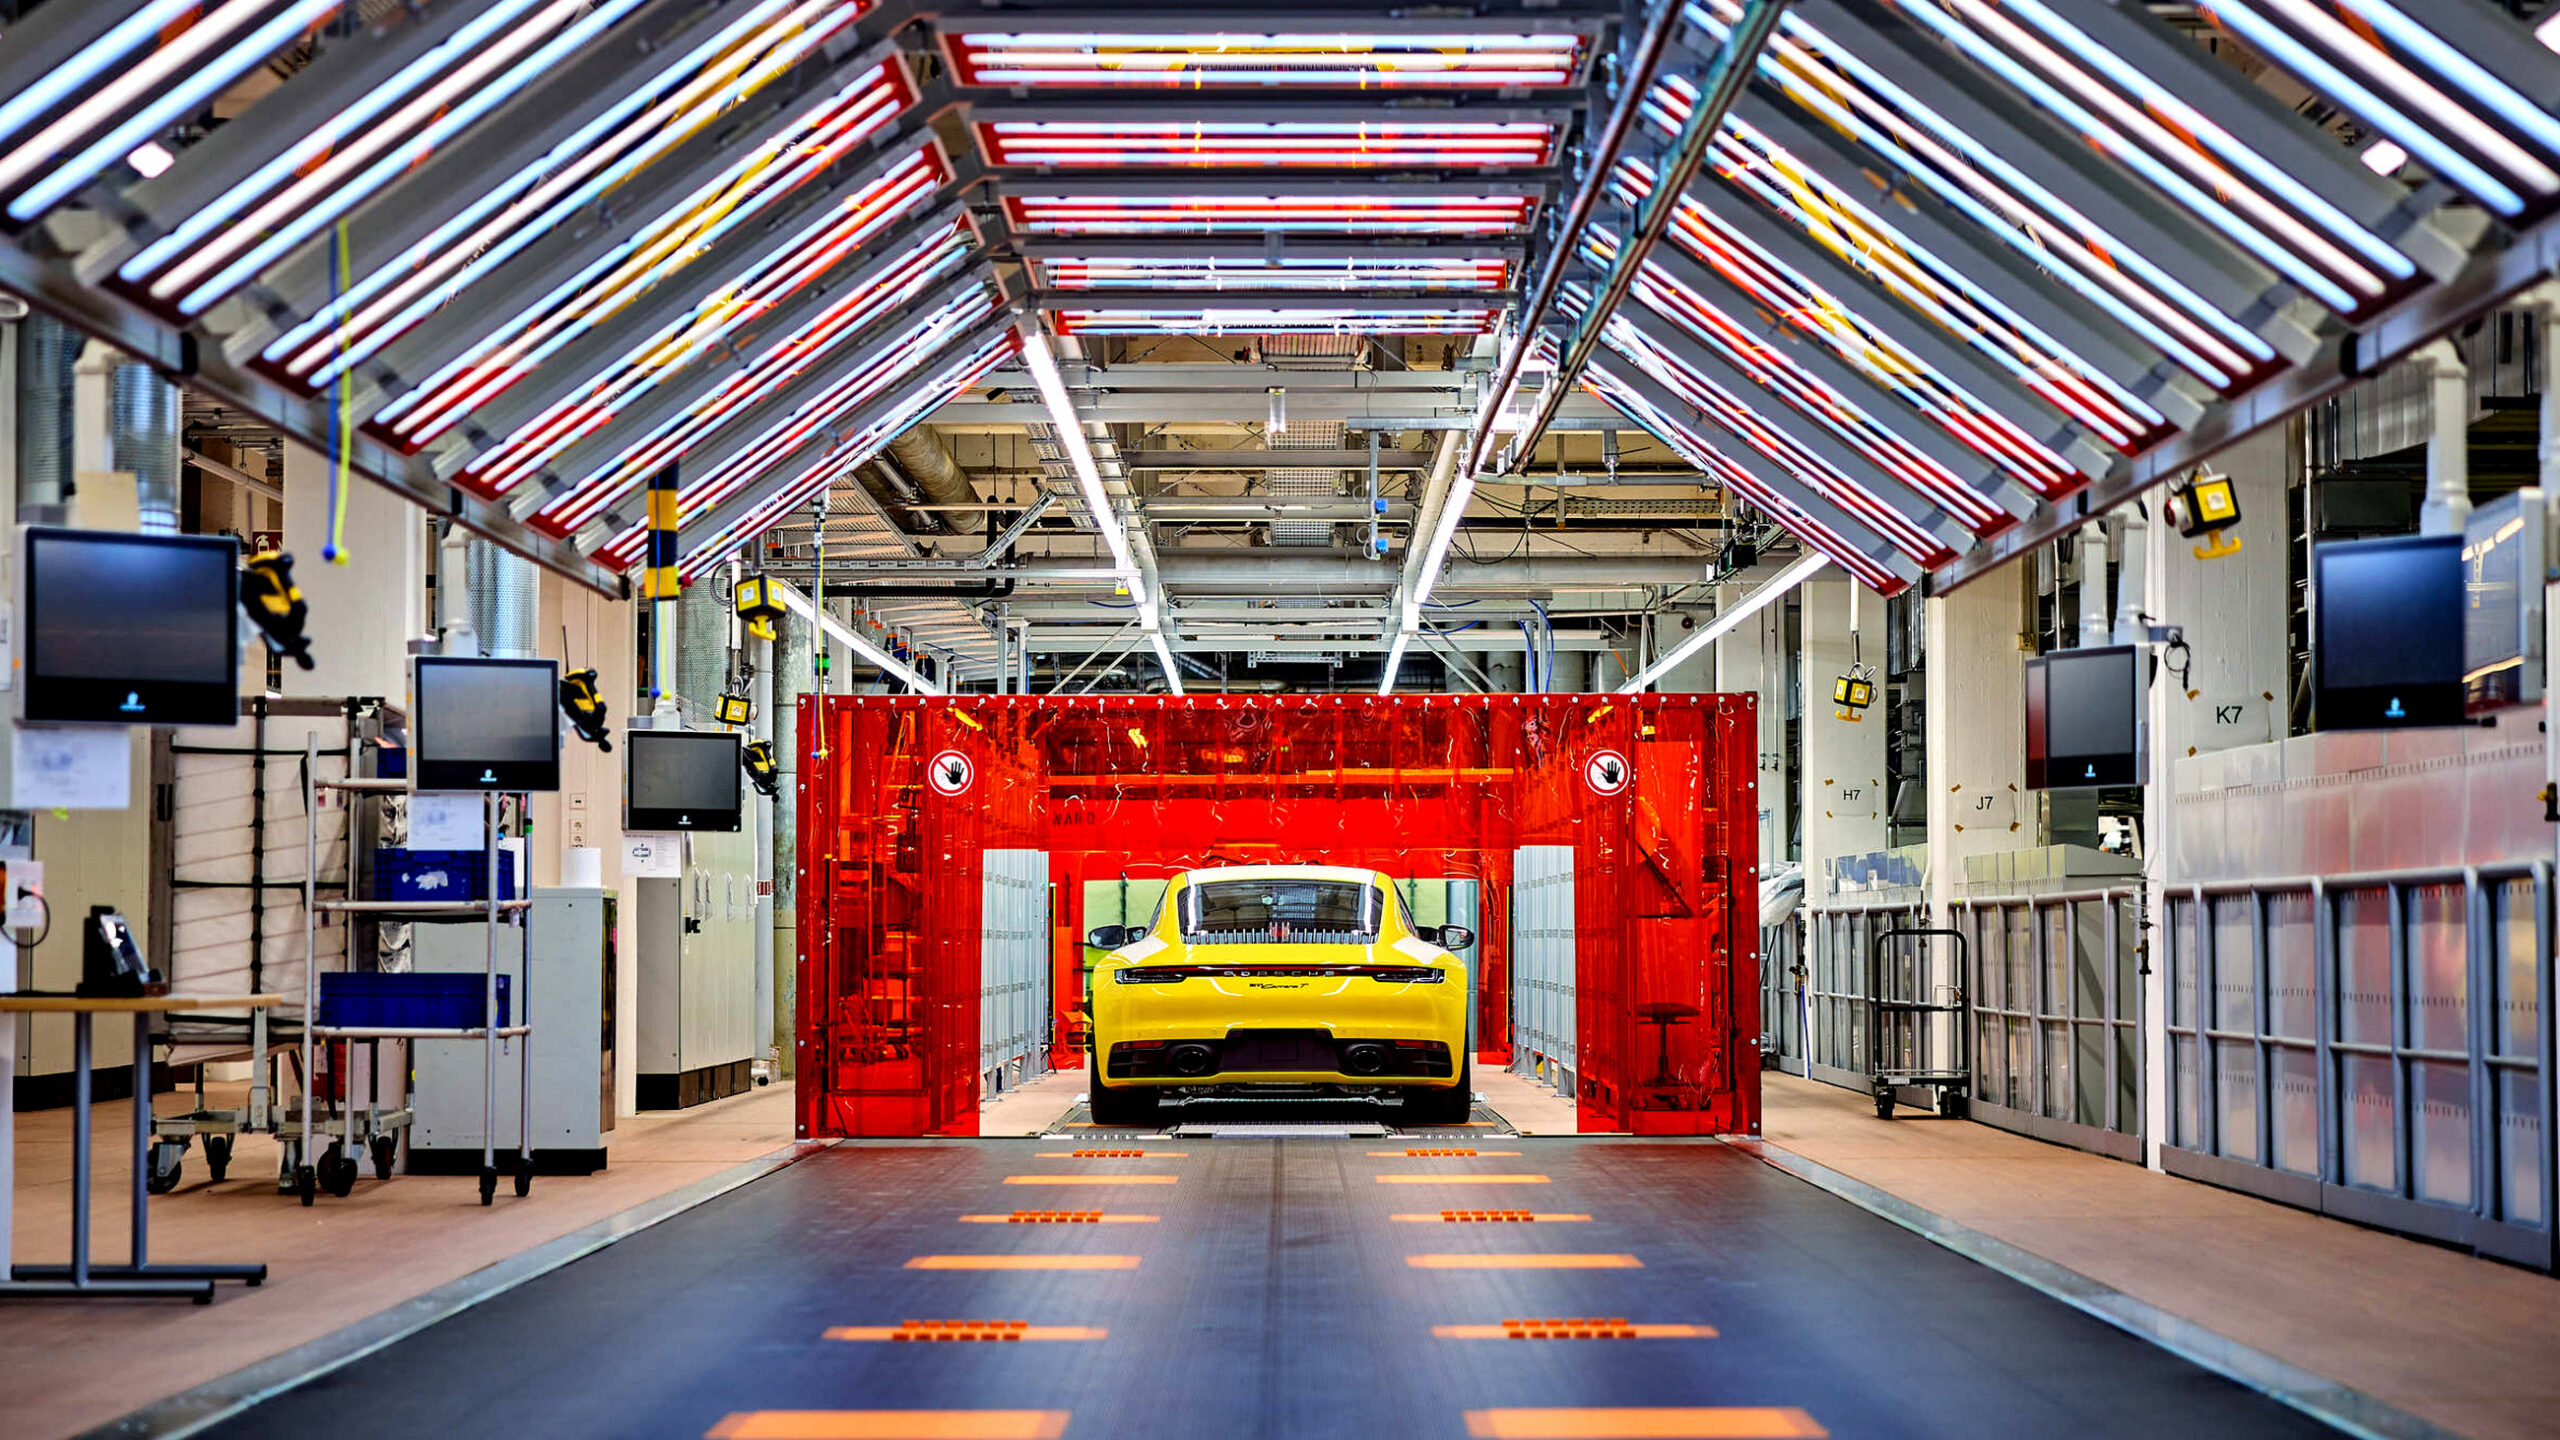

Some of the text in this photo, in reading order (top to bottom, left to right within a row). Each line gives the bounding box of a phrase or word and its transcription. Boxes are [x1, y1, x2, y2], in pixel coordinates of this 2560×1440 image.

[2216, 705, 2243, 724] K7
[1843, 789, 1861, 801] H7
[1976, 796, 1994, 810] J7
